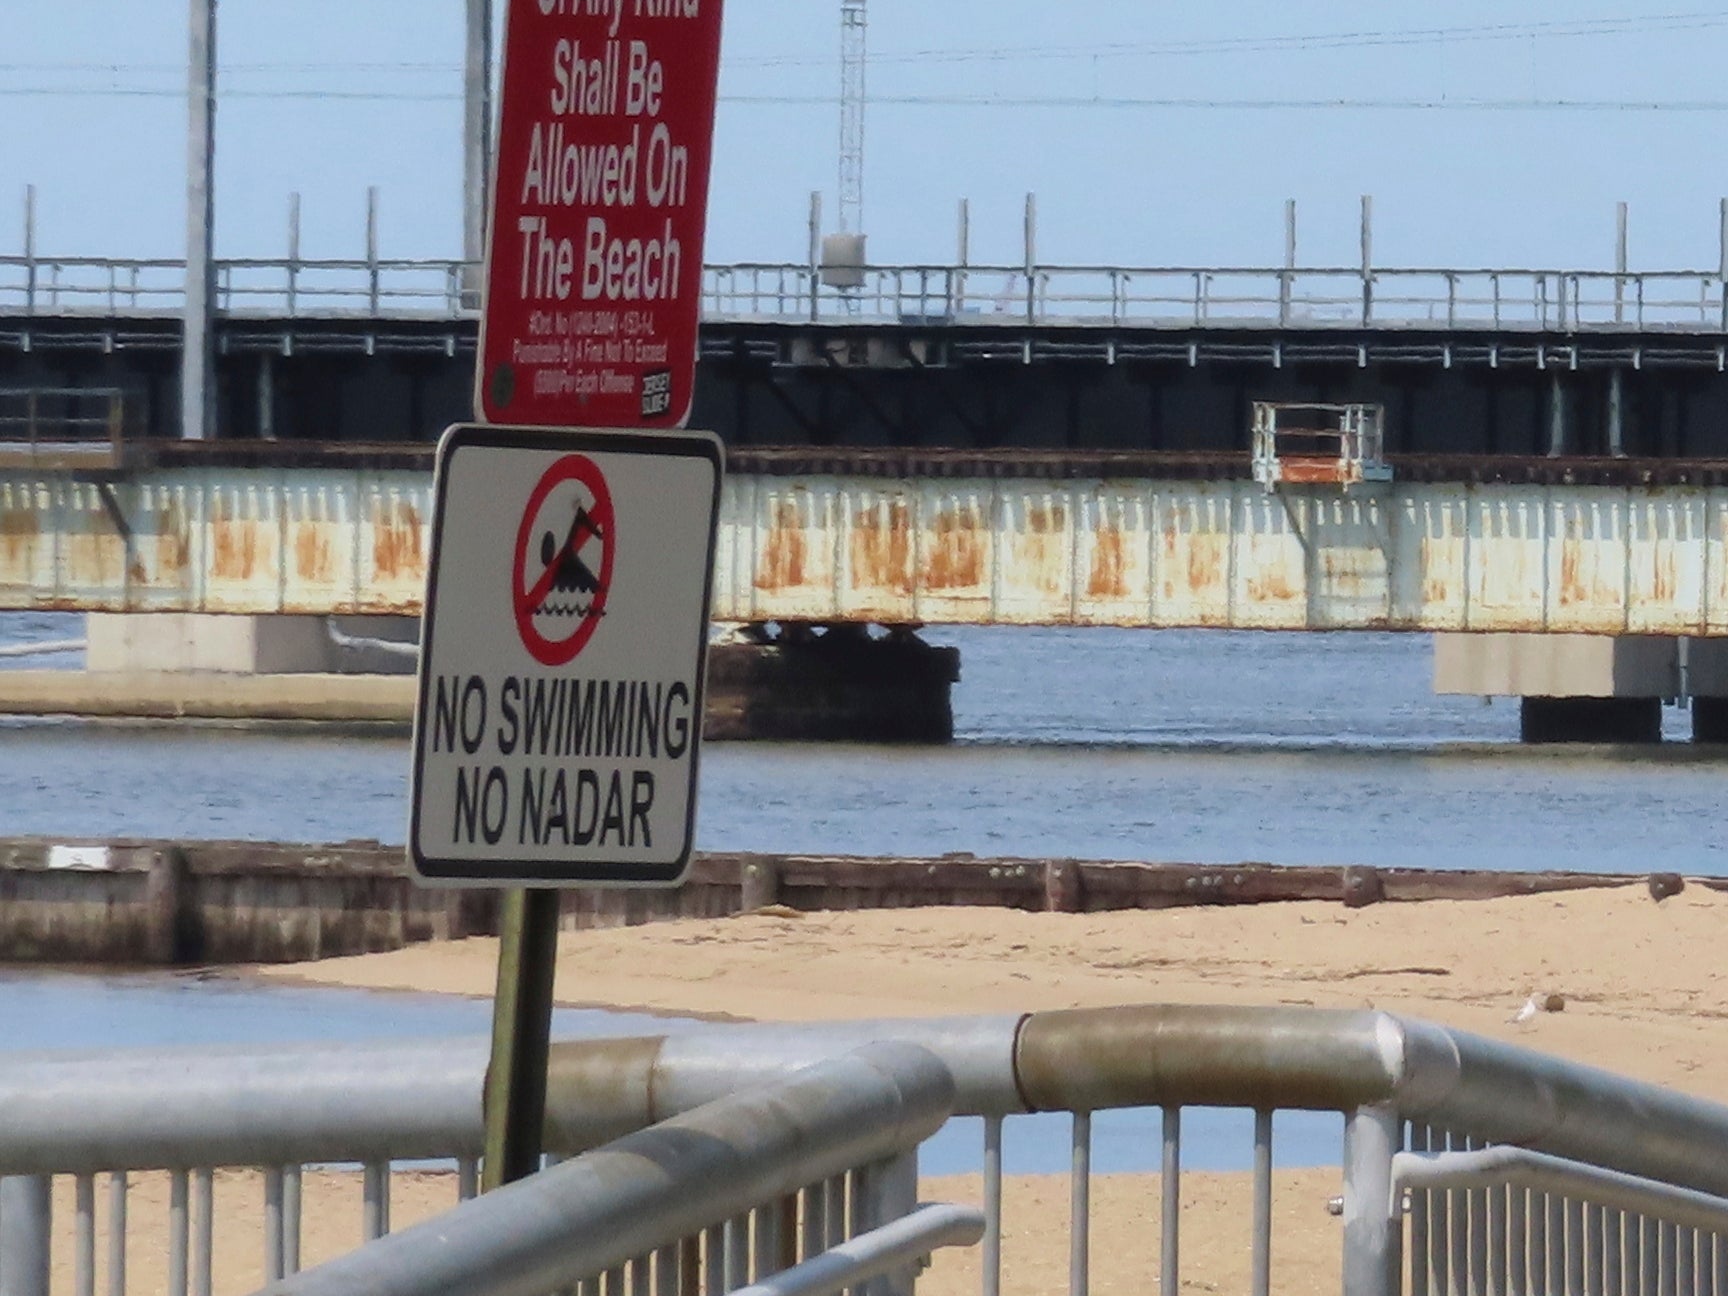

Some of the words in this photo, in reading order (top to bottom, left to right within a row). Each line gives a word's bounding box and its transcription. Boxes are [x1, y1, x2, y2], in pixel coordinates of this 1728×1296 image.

[552, 39, 619, 115] Shall
[626, 41, 662, 116] Be
[522, 123, 638, 206] Allowed
[647, 123, 687, 206] On
[519, 217, 572, 299] The
[583, 218, 680, 300] Beach
[433, 675, 487, 755] NO
[498, 676, 689, 759] SWIMMING
[453, 766, 508, 845] NO
[519, 767, 654, 847] NADAR
